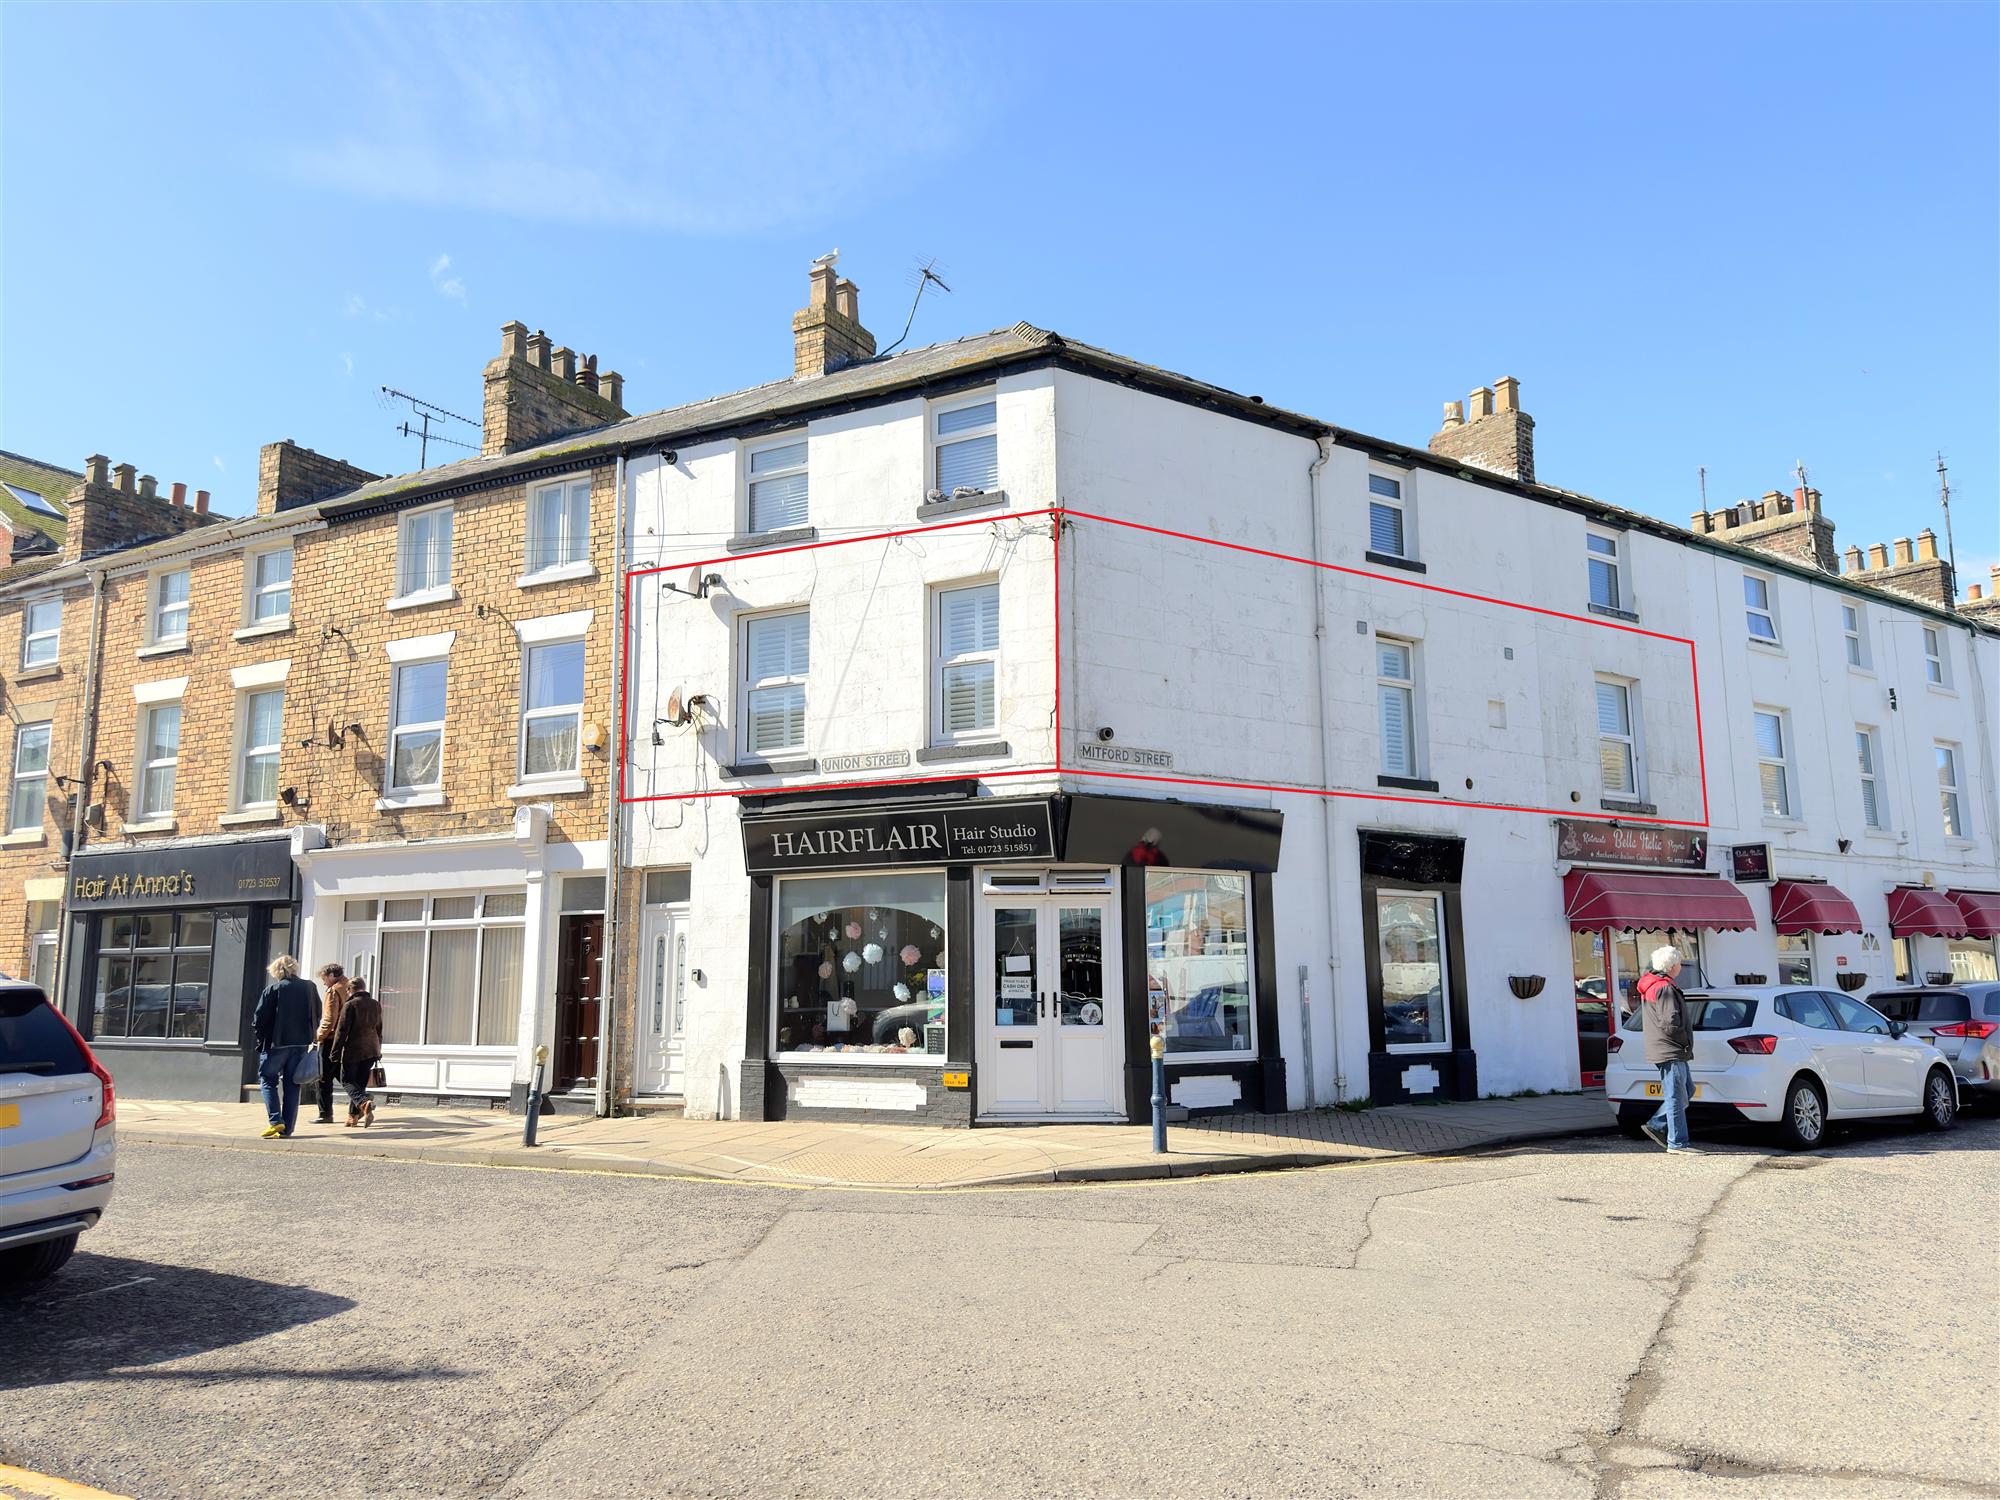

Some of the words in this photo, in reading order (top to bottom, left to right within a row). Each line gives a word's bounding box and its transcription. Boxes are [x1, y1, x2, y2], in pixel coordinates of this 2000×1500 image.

[824, 757, 860, 771] UNION
[865, 753, 907, 768] STREET
[1082, 745, 1129, 761] MITFORD
[1134, 752, 1171, 766] STREET
[771, 824, 943, 857] HAIRFLAIR
[953, 827, 985, 841] Hair
[990, 823, 1037, 839] Studio
[1613, 828, 1637, 848] Bella
[1640, 830, 1664, 851] Italia
[961, 846, 976, 855] Tel:
[977, 845, 1002, 854] 01723
[1004, 843, 1033, 853] 515851
[74, 875, 107, 899] Hair
[108, 873, 130, 896] At
[131, 869, 193, 895] Anna's
[238, 878, 256, 889] 01723
